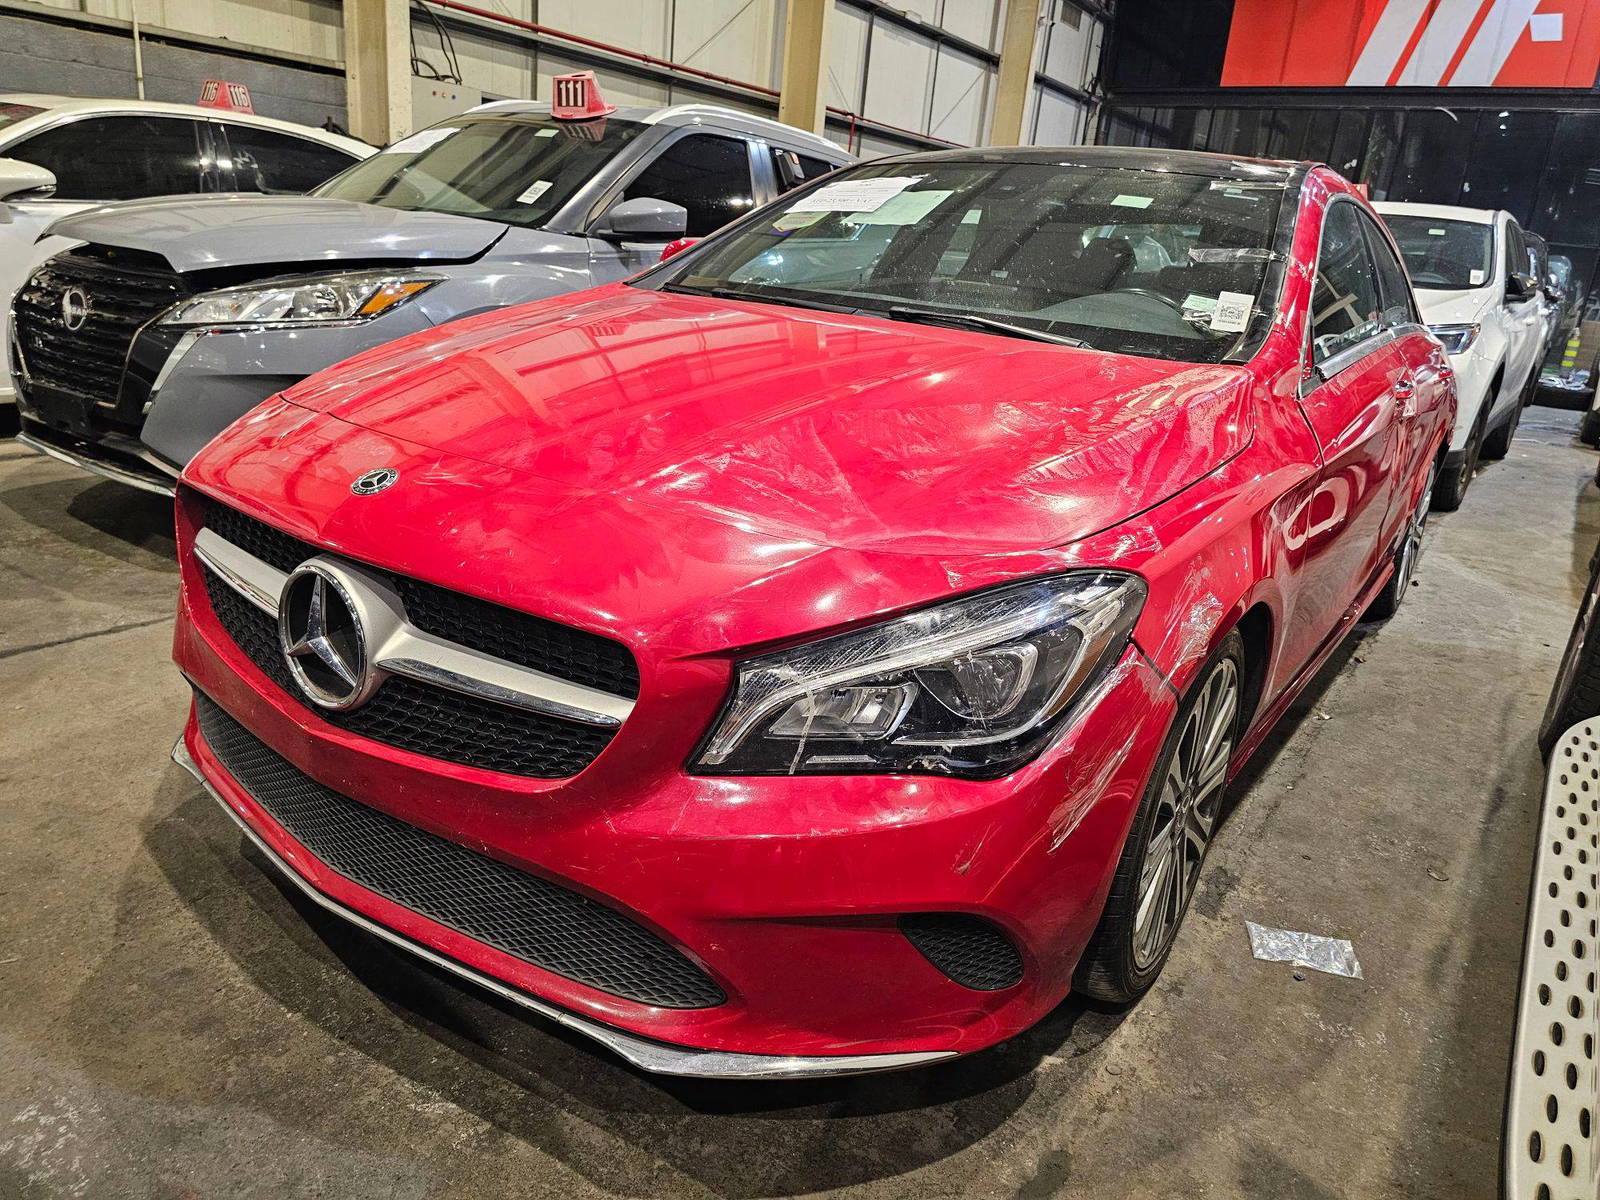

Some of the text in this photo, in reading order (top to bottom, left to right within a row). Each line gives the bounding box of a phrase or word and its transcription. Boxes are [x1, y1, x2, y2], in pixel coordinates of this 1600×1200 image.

[202, 81, 219, 101] 116
[229, 85, 248, 107] 116
[559, 80, 583, 107] 111
